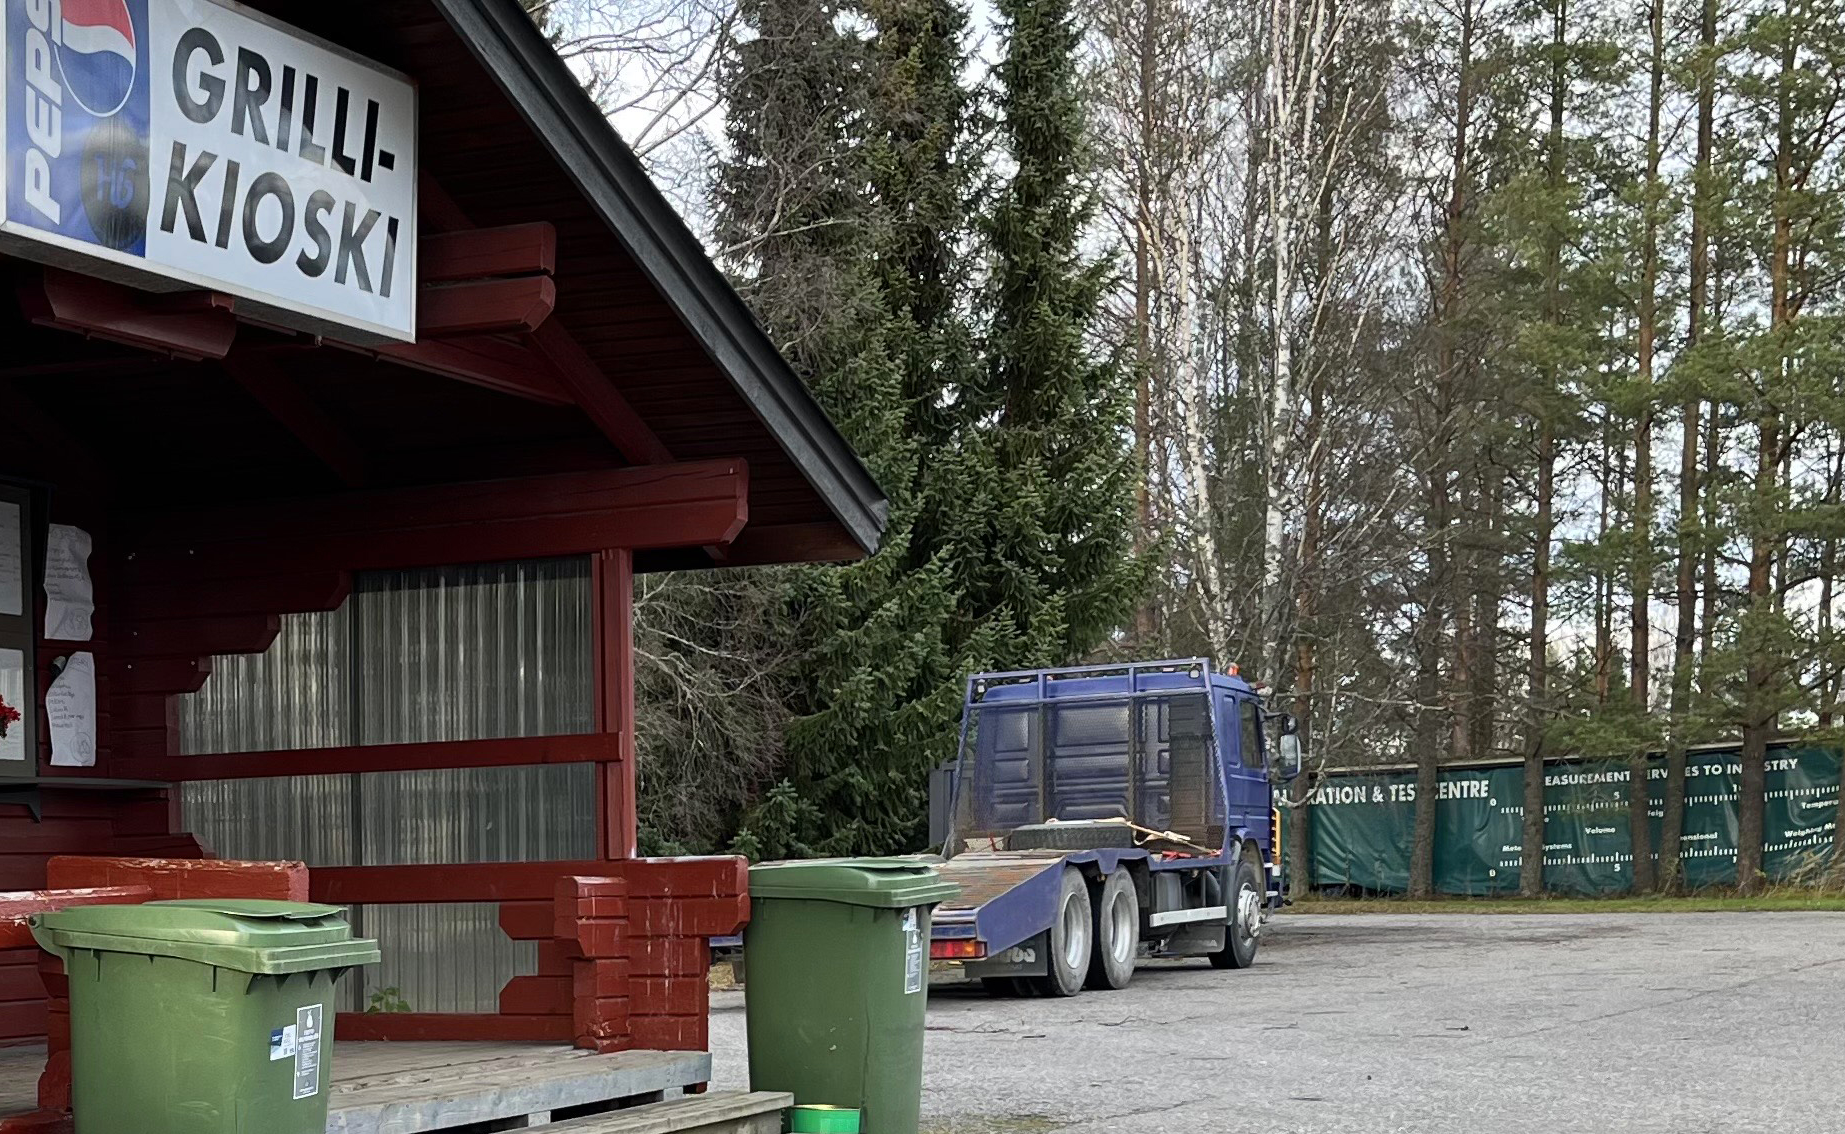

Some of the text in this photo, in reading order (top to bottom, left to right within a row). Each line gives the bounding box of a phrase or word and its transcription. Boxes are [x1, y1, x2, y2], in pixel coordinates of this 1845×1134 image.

[171, 26, 396, 184] GRILLI-
[159, 139, 400, 299] KIOSKI
[1372, 786, 1385, 803] &
[1390, 784, 1417, 802] TES
[1545, 770, 1631, 787] EASUREMENT
[1703, 764, 1723, 776] TO
[1727, 758, 1798, 775] INSTRY
